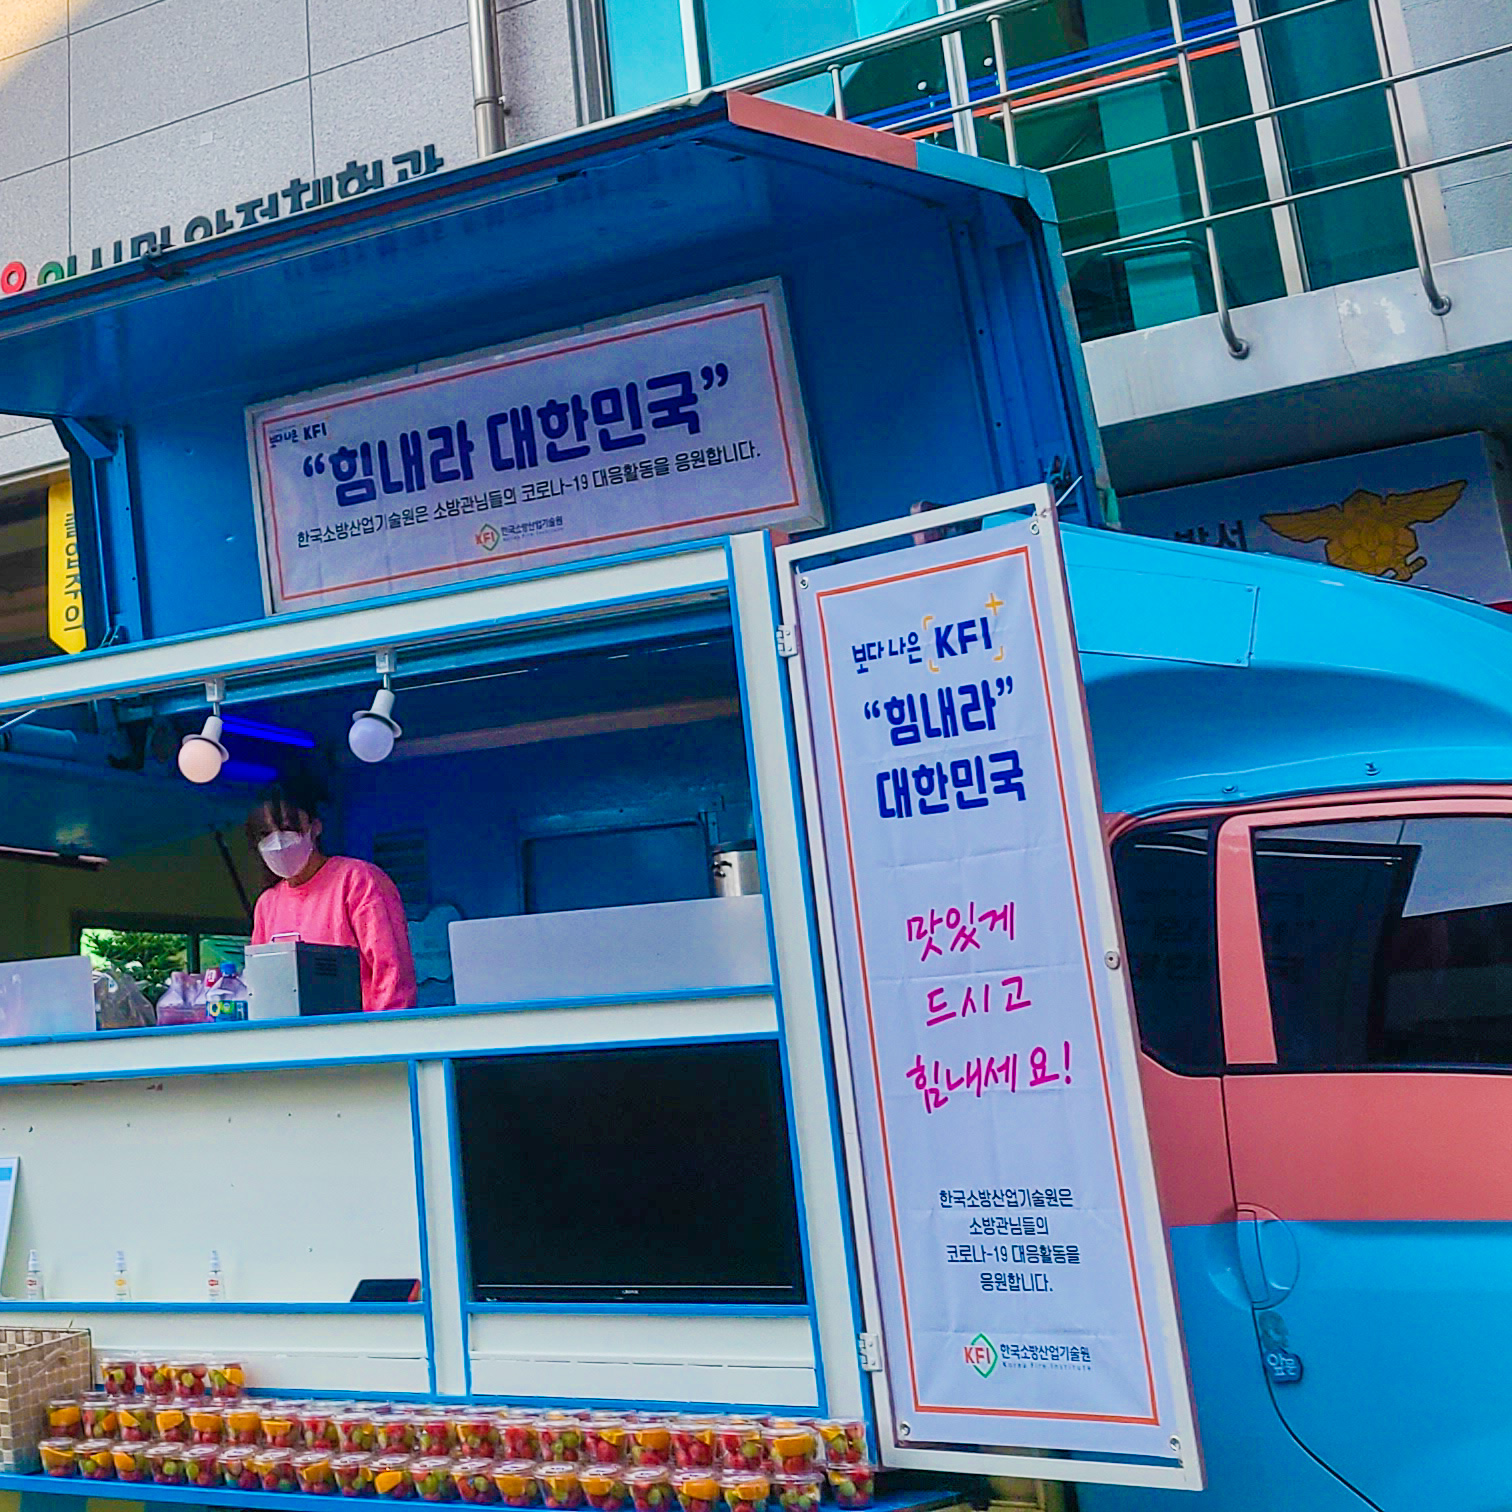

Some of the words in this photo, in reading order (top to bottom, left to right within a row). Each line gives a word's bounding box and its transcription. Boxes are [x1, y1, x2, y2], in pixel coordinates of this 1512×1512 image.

[303, 422, 327, 441] KFI
[303, 419, 475, 507] “힘내라
[486, 362, 729, 472] 대한민국”
[297, 505, 429, 548] 한국소방산업기술원은
[433, 488, 517, 520] 소방관님들의
[521, 472, 589, 502] 코로나-19
[592, 456, 670, 488] 대응활동을
[674, 440, 761, 473] 응원합니다.
[474, 531, 496, 546] KFI
[934, 617, 993, 659] KFI
[864, 675, 1014, 747] “힘내라”
[876, 750, 1027, 819] 대한민국
[906, 901, 1015, 962] 맛있게
[926, 975, 1032, 1027] 드시고
[906, 1040, 1072, 1114] 힘내세요!
[939, 1188, 1074, 1209] 한국소방산업기술원은
[969, 1216, 1049, 1236] 소방관님들의
[946, 1245, 1008, 1263] 코로나-19
[1011, 1244, 1081, 1264] 대응활동을
[980, 1272, 1054, 1292] 응원합니다.
[964, 1346, 990, 1364] KFI
[1000, 1343, 1091, 1362] 한국소방산업기술원
